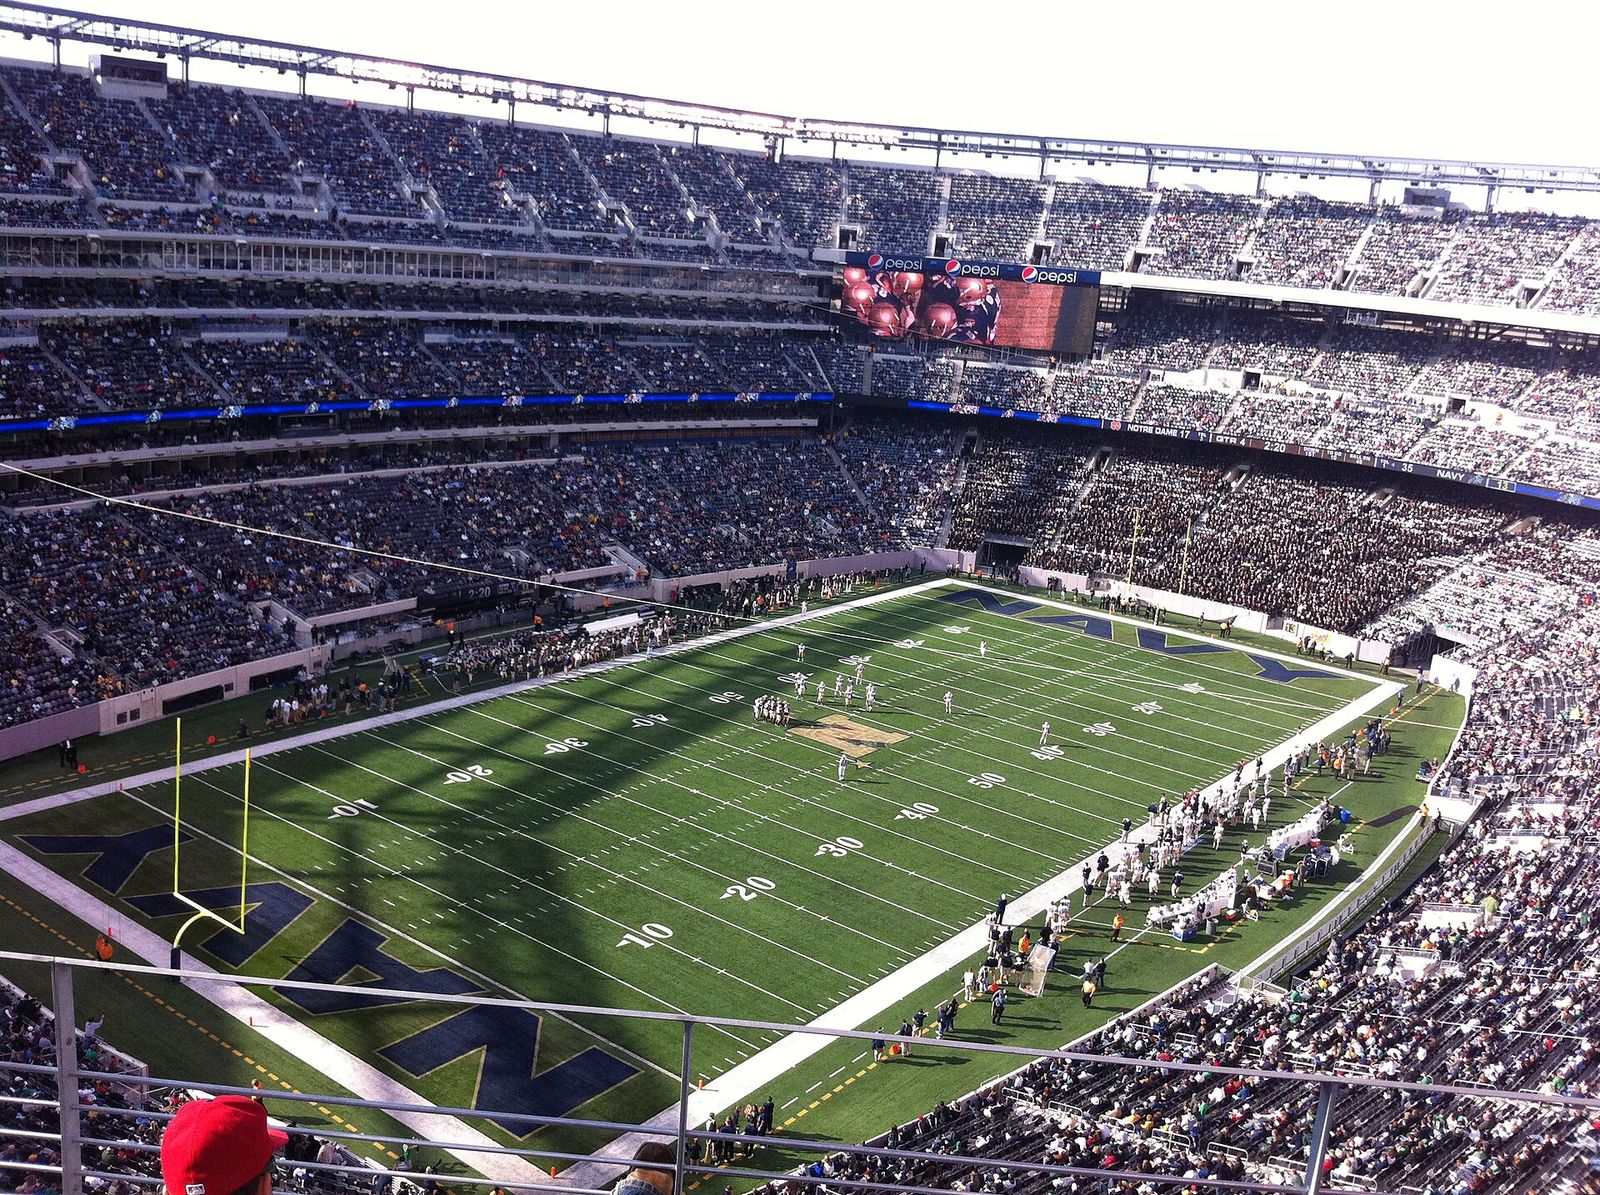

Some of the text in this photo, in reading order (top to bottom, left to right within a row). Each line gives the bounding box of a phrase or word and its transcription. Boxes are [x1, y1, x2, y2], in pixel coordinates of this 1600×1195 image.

[884, 255, 923, 273] pepsi
[961, 263, 1000, 278] pepsi
[1037, 269, 1078, 284] pepsi
[1127, 423, 1191, 439] NOTRE DAME 17
[1215, 435, 1246, 447] QTR 4
[1263, 441, 1287, 453] 2:20
[1401, 462, 1414, 473] 35
[1436, 469, 1465, 481] NAVY
[468, 586, 491, 599] 2:20
[936, 588, 1356, 684] NAVY
[708, 691, 745, 704] 50
[631, 713, 670, 728] 40
[545, 737, 589, 753] 30
[1030, 745, 1065, 760] 40
[446, 764, 493, 783] 20
[966, 772, 1007, 789] 50
[332, 798, 379, 817] 10
[899, 802, 940, 820] 40
[818, 836, 865, 857] 30
[726, 876, 776, 901] 20
[622, 923, 674, 949] 10
[13, 823, 645, 1141] NAVY
